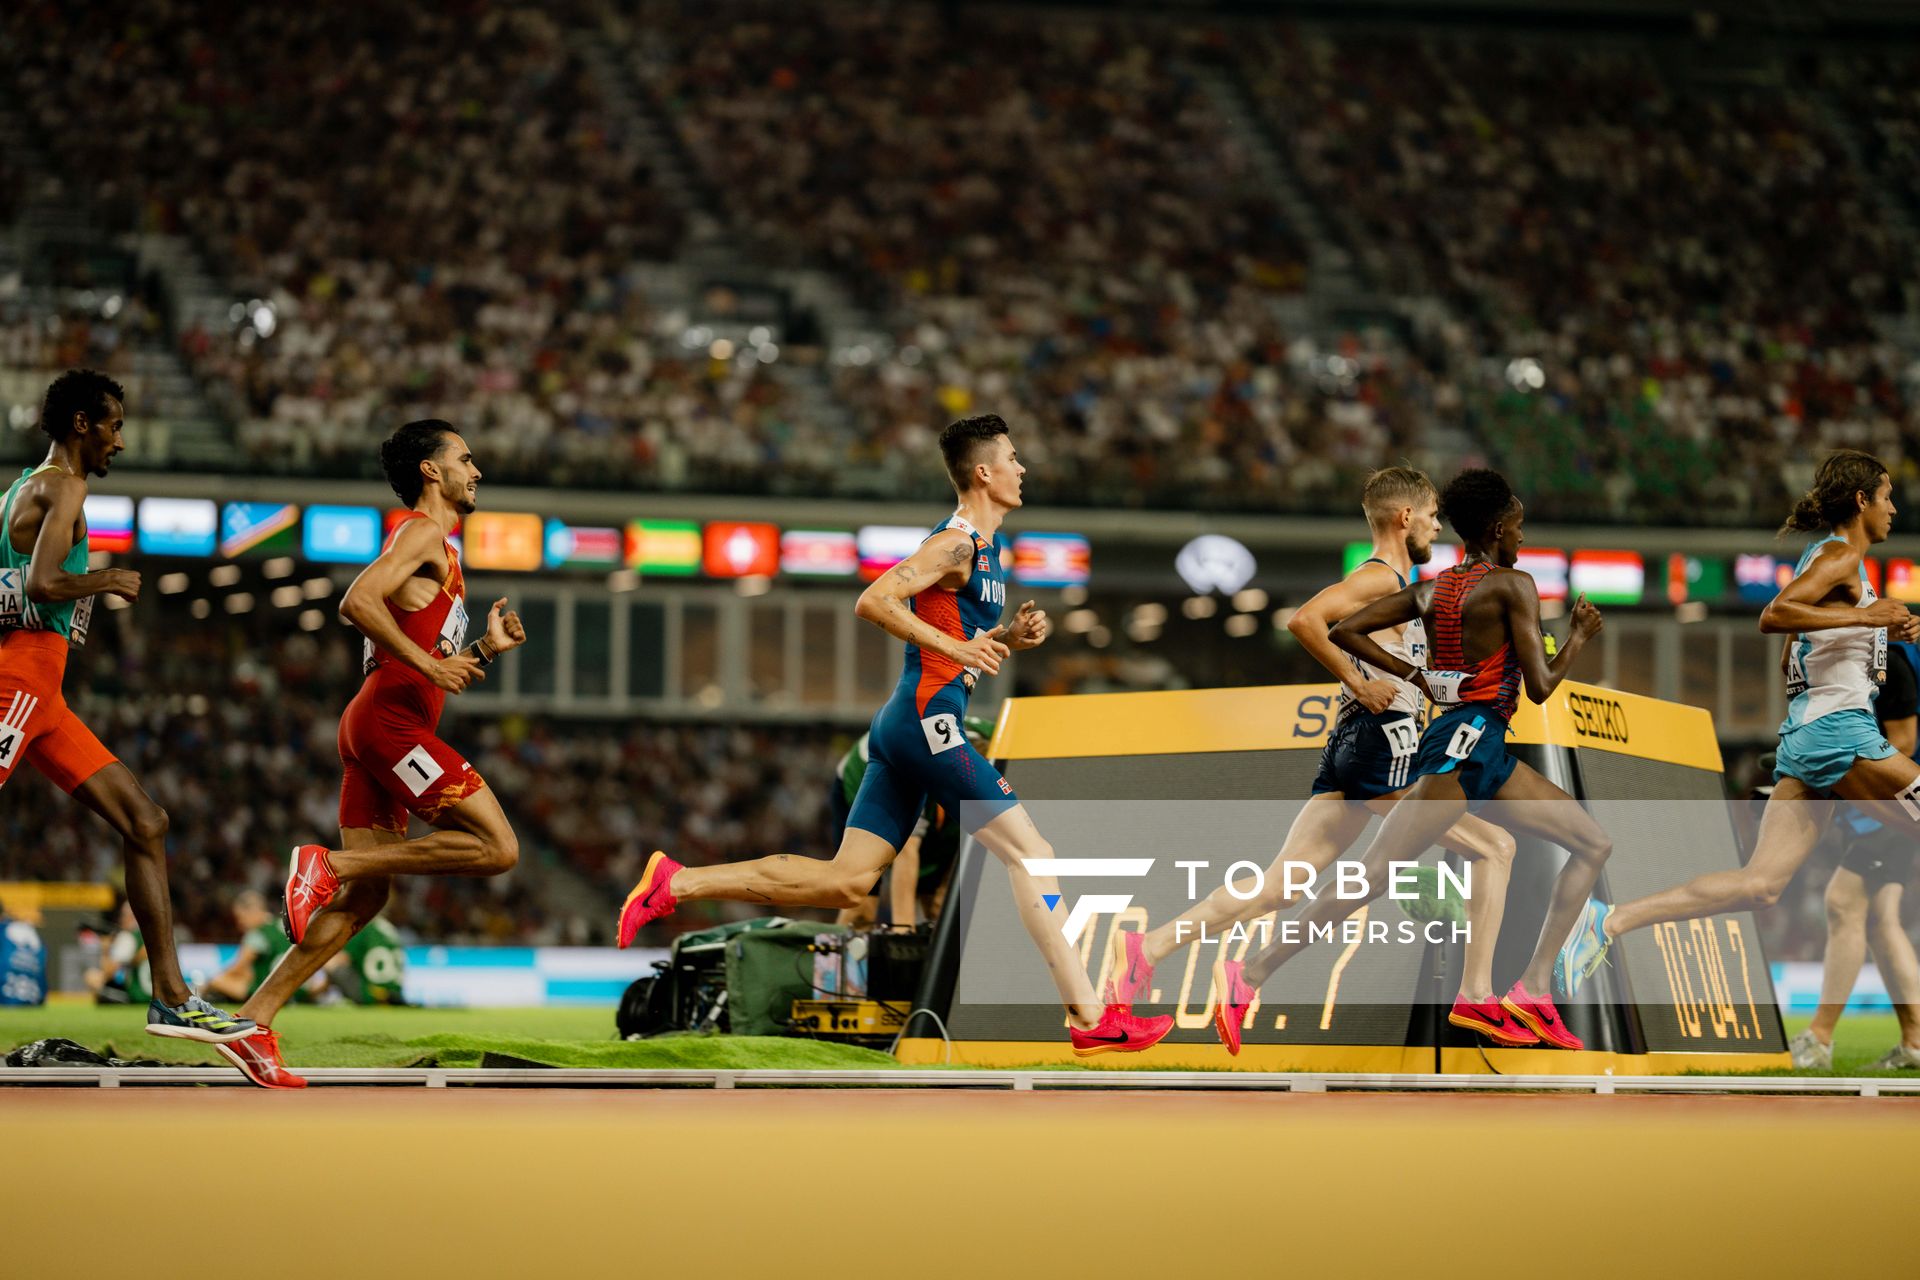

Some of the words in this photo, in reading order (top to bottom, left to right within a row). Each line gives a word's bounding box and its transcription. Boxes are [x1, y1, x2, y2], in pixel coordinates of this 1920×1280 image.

[1569, 691, 1629, 744] SEIKO
[934, 718, 951, 745] 9
[1389, 724, 1416, 751] 12
[407, 758, 430, 781] 1
[1652, 916, 1763, 1040] 10:04.7
